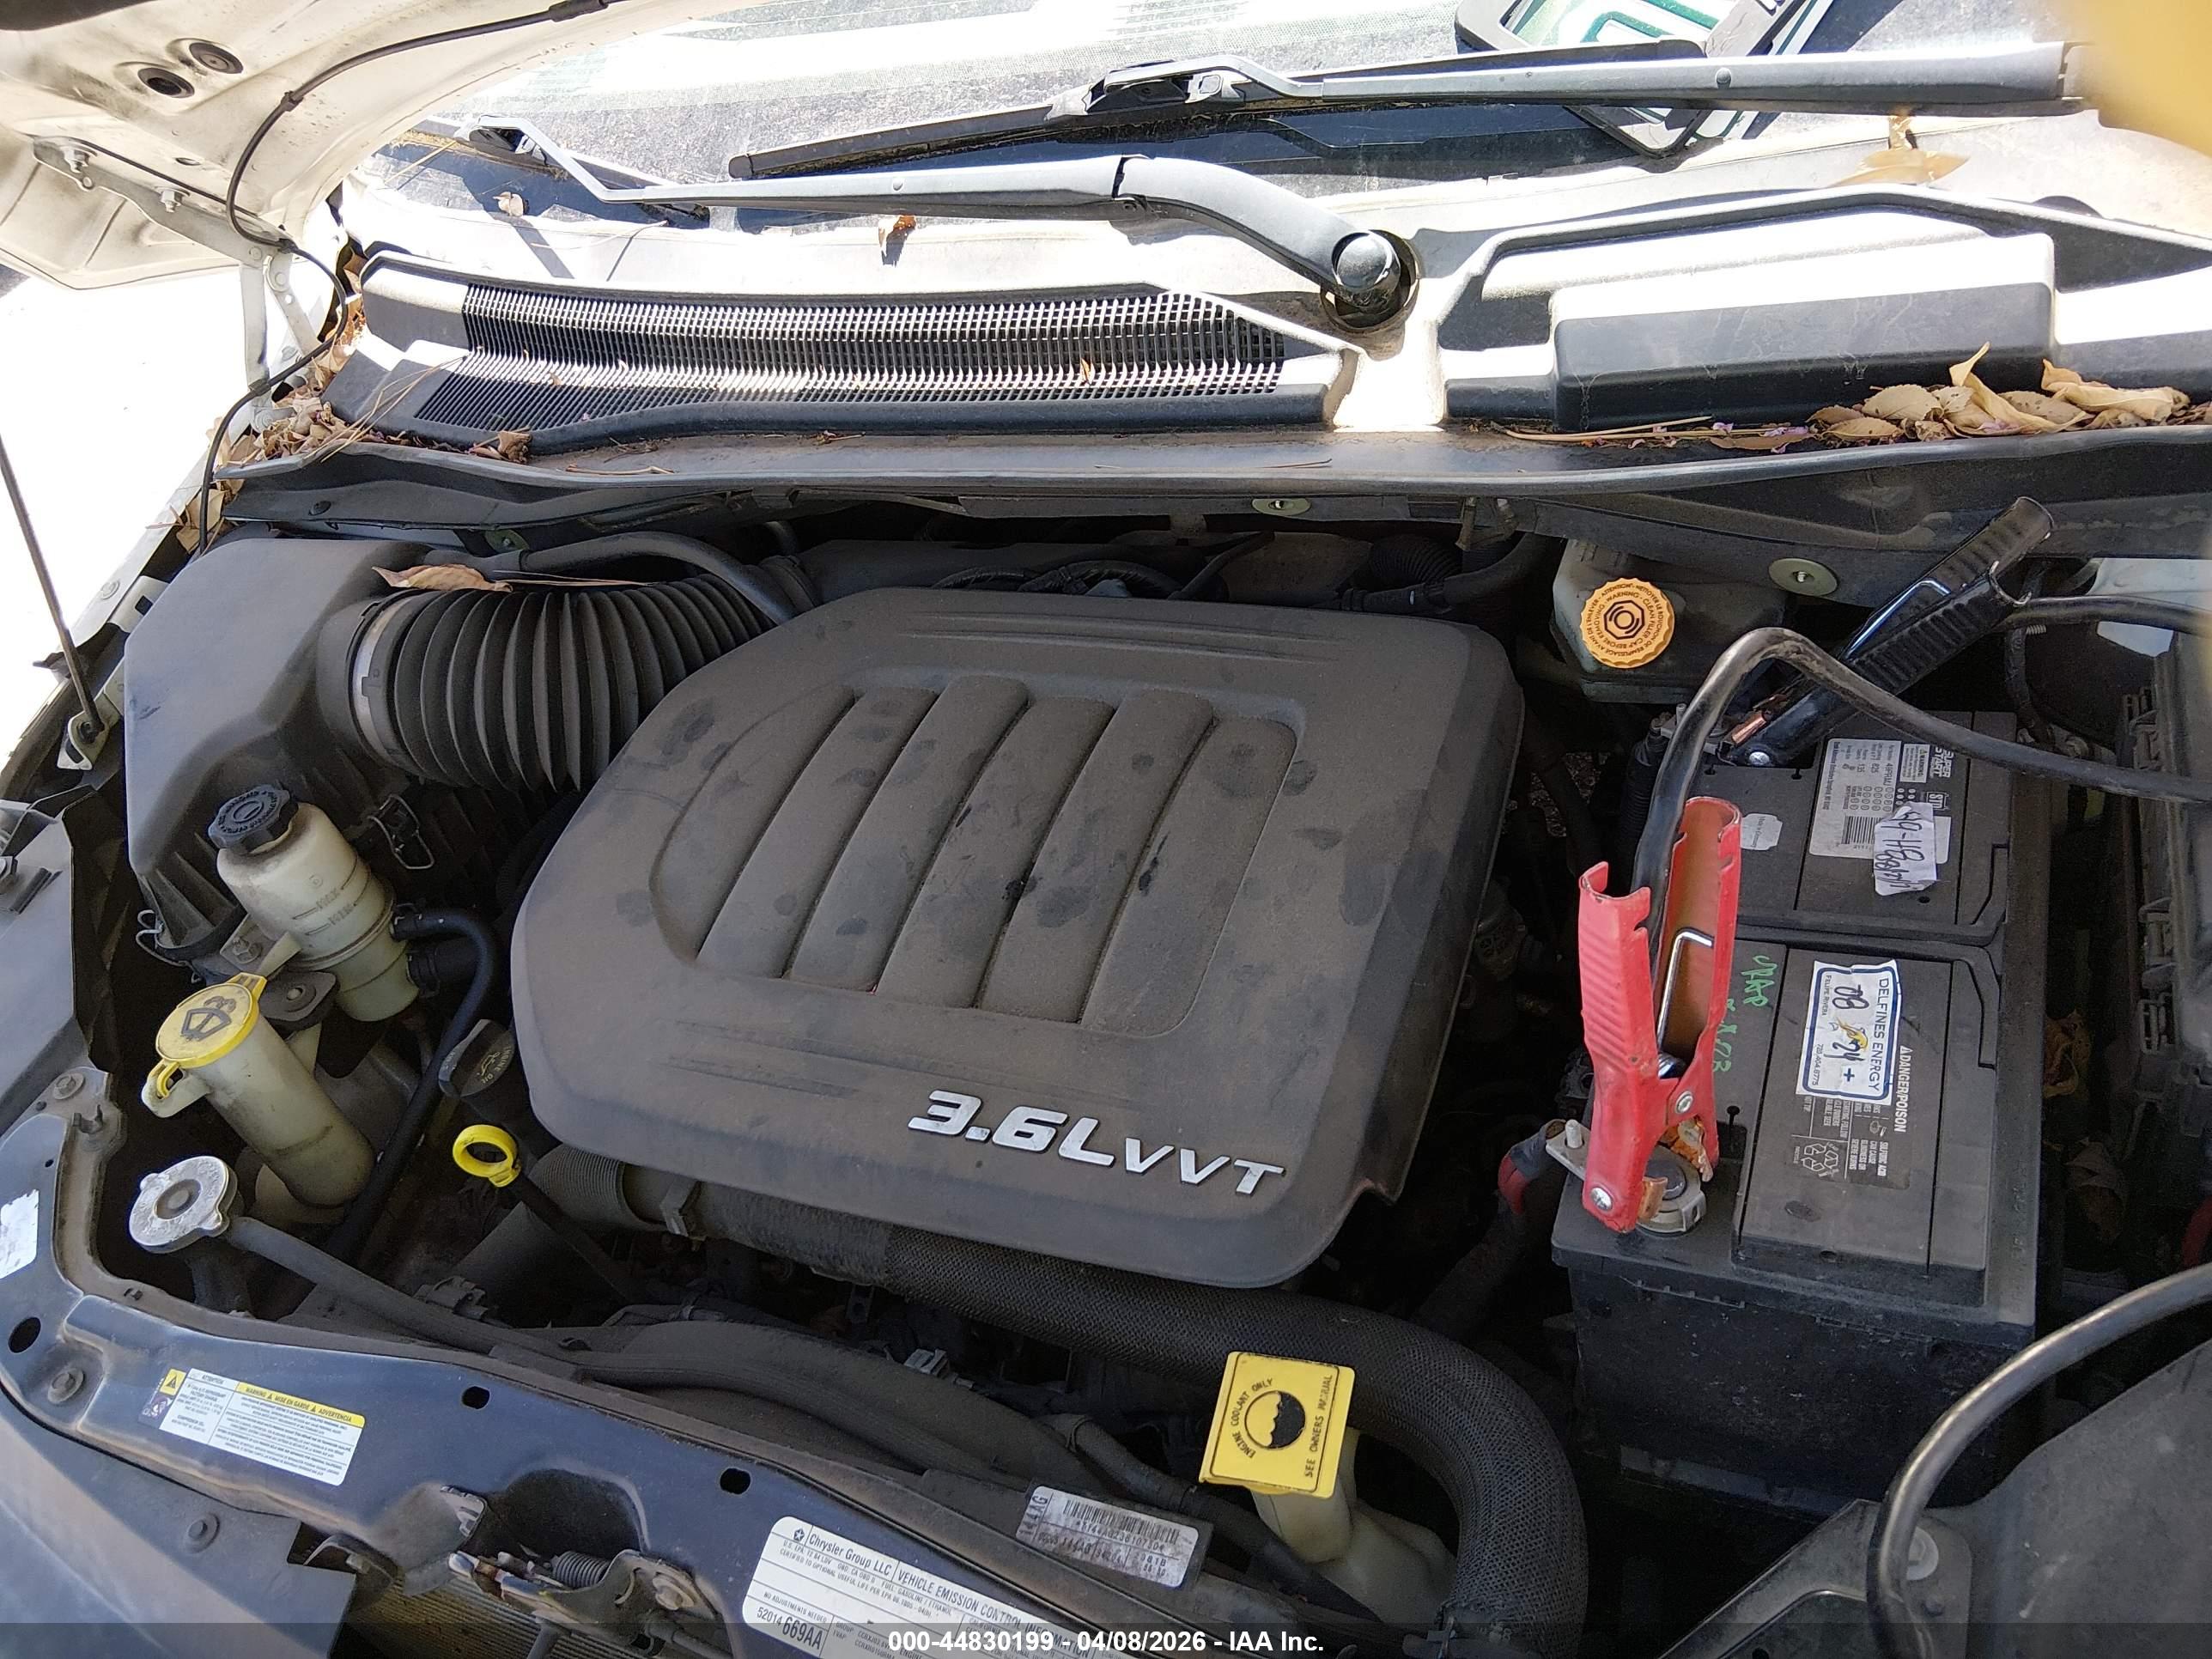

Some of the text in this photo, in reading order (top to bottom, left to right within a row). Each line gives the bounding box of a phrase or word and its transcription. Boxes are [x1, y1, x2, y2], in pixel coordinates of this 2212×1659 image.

[1643, 599, 1655, 618] CLEAN
[1821, 996, 1830, 1016] RIVERA
[1873, 979, 1889, 1039] DELFINES
[1868, 1042, 1883, 1091] ENERGY
[1893, 1054, 1909, 1132] DANGER/POISON
[908, 1090, 1285, 1194] 3.6L VVT
[318, 1407, 352, 1423] ADVERTENCIA
[1231, 1378, 1273, 1459] ENGINE COOLANT ONLY
[1310, 1415, 1324, 1452] OWNERS
[1305, 1460, 1316, 1478] SEE
[809, 1534, 892, 1577] Chrysler Group LLC
[837, 1571, 857, 1586] USEFUL
[897, 1570, 933, 1593] VEHICLE
[935, 1585, 980, 1612] EMISSION
[980, 1604, 1023, 1629] CONTROL
[772, 1595, 807, 1615] ADJUSTMENTS
[757, 1607, 823, 1650] 52014 669AA
